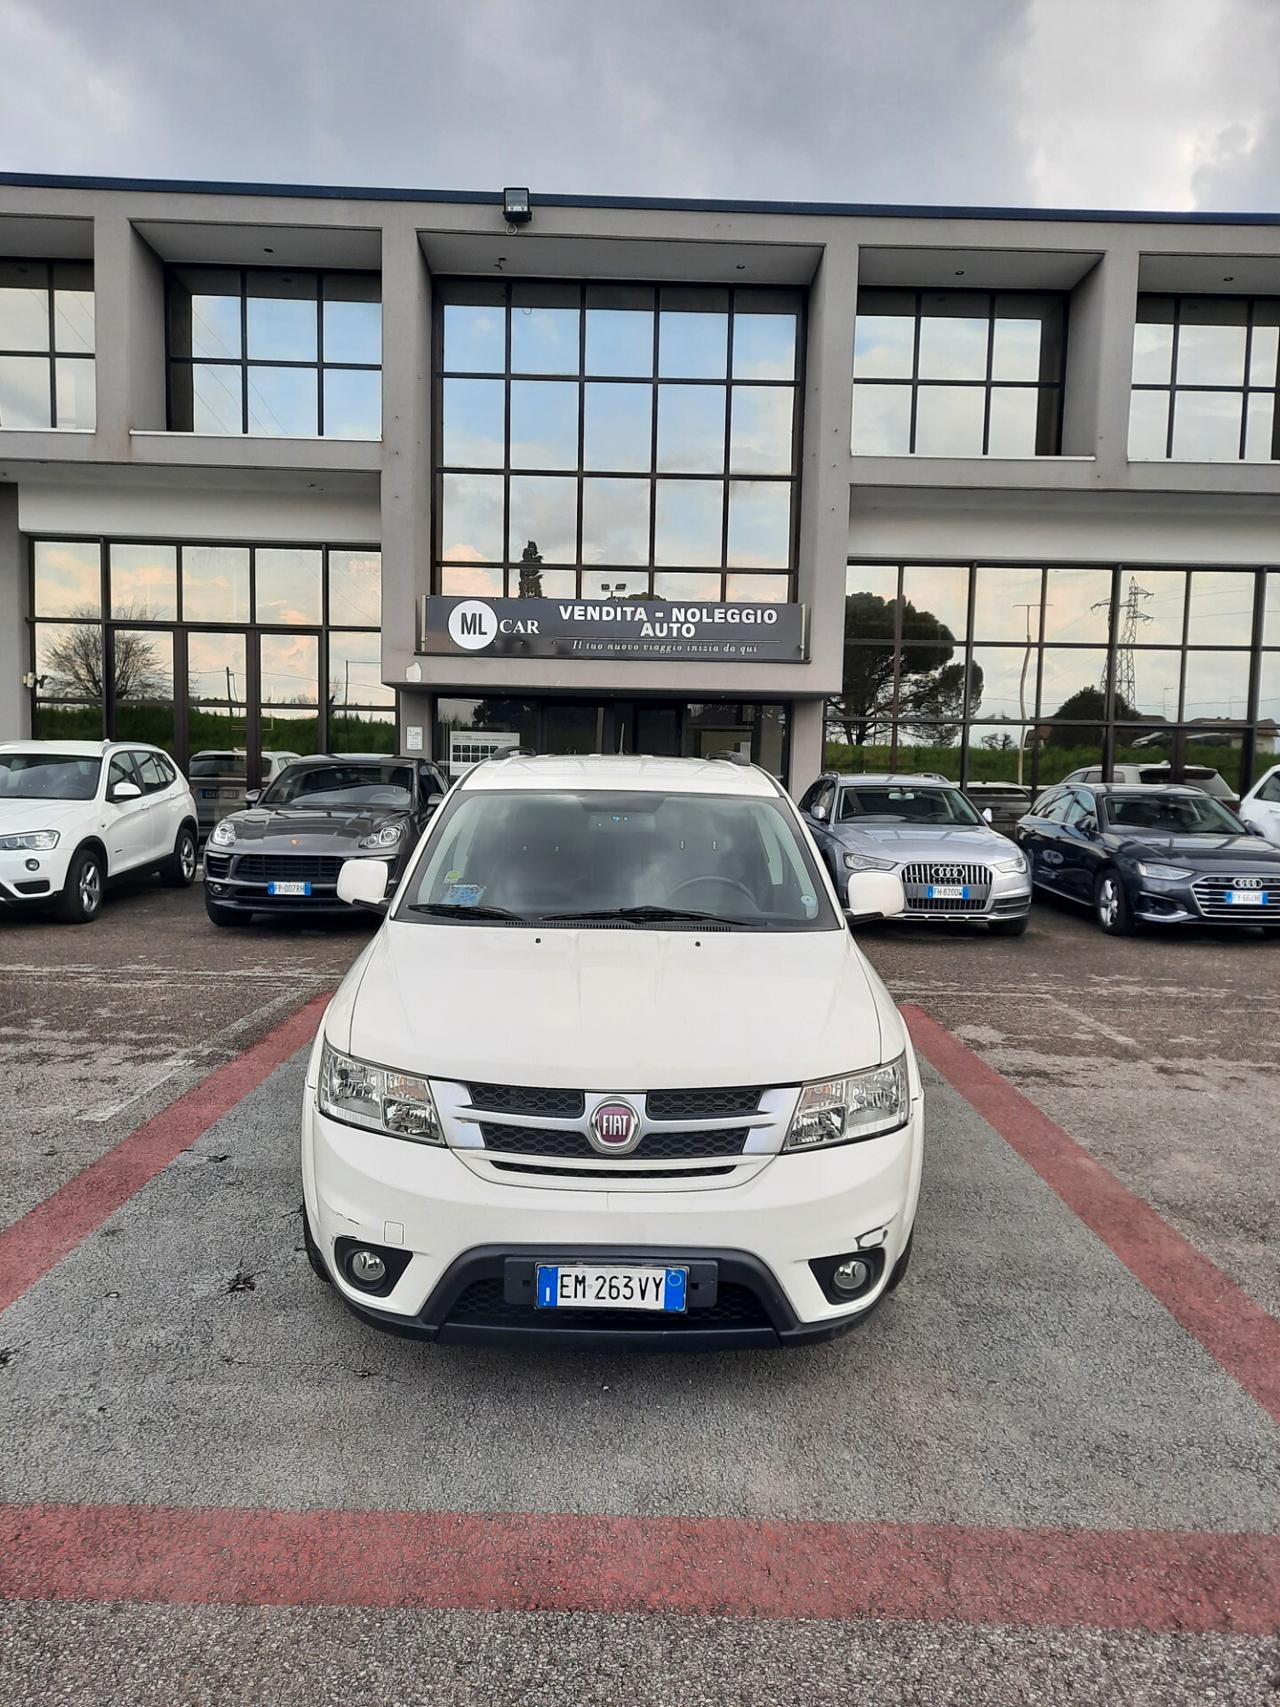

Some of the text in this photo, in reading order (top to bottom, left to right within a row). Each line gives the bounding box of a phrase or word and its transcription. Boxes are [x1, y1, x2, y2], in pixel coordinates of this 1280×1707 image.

[461, 612, 540, 635] ML CAR
[559, 605, 648, 621] VENDITA
[672, 608, 777, 624] NOLEGGIO
[640, 622, 695, 638] AUTO
[586, 640, 603, 650] tuo
[607, 642, 639, 651] nuovo
[643, 641, 682, 654] viaggio
[686, 642, 719, 652] inizia
[723, 643, 736, 652] da
[740, 643, 758, 655] qui
[602, 1114, 629, 1136] FIAT
